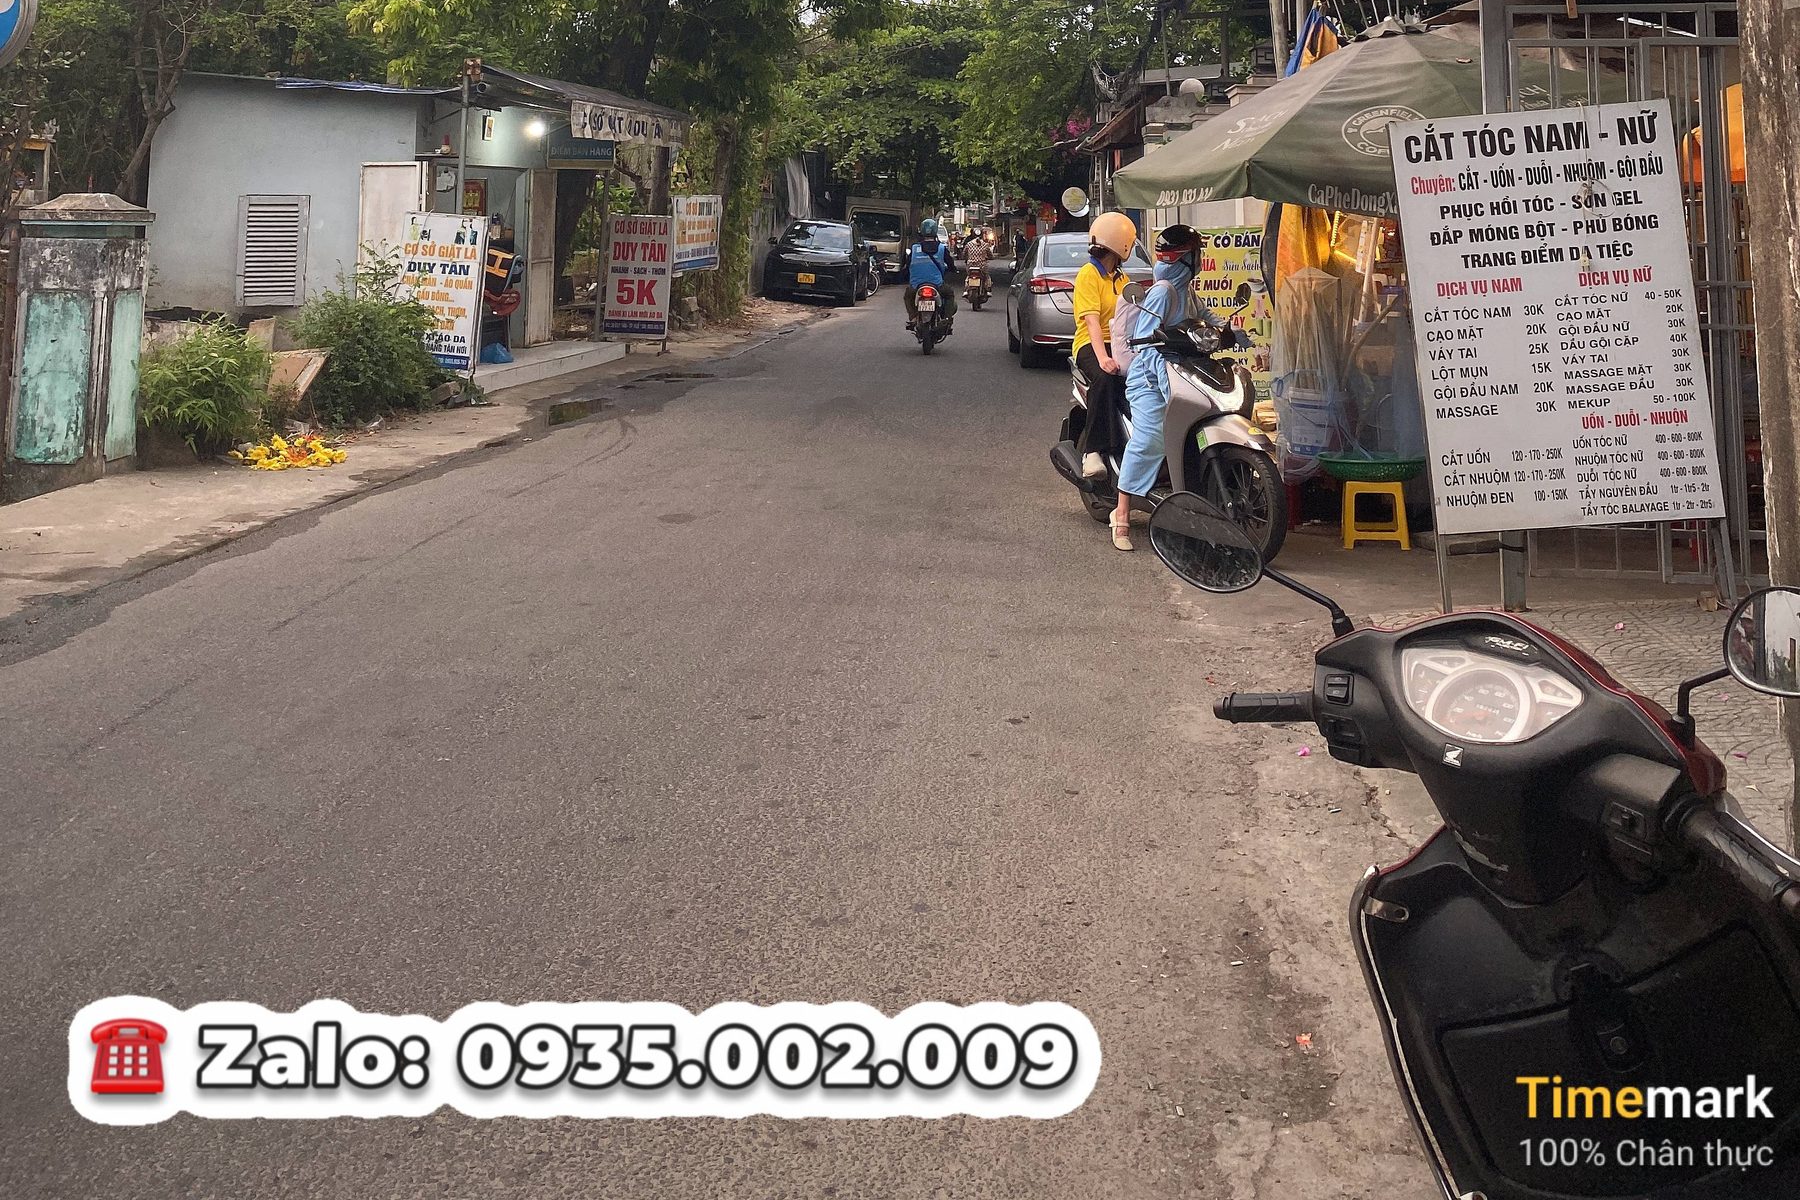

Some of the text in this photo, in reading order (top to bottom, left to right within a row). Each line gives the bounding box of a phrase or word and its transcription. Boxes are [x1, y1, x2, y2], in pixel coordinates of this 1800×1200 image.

[1404, 109, 1658, 164] CẮT TÓC NAM NỮ
[1411, 150, 1664, 195] Chuyên: CẮT UỐN DUỖI NHUỘM GỘI ĐẦU
[1440, 202, 1484, 221] PHỤC
[1490, 196, 1518, 216] HỒI
[1522, 195, 1554, 213] TÓC
[1612, 190, 1643, 206] GEL
[1430, 214, 1659, 246] ĐẮP MÓNG BỘT PHỦ BÓNG
[1214, 231, 1260, 248] CÓ BÁN
[613, 241, 639, 262] DUY
[641, 240, 667, 262] TÂN
[1461, 241, 1634, 269] TRANG ĐIỂM TIỆC
[1203, 274, 1232, 291] MUỐI
[1578, 266, 1653, 289] DỊCH VỤ NỮ
[616, 279, 658, 305] 5K
[1437, 277, 1523, 299] DỊCH VỤ NAM
[1554, 289, 1682, 306] CẮT TÓC NỮ 40 50K
[1424, 304, 1544, 323] CẮT TÓC NAM 30K
[1556, 304, 1684, 322] CẠO MẶT 20K
[1427, 323, 1547, 343] CẠO MẶT 20K
[1558, 324, 1580, 336] GỘI
[1613, 321, 1630, 332] NỮ
[1668, 318, 1686, 328] 30K
[1589, 337, 1611, 349] GỘI
[1615, 336, 1639, 348] CẶP
[1670, 333, 1688, 343] 40K
[1429, 342, 1550, 361] VÁY TAI 25K
[1562, 348, 1690, 365] VÁY TAI 30K
[1431, 362, 1552, 382] LỘT MỤN 15K
[1564, 362, 1692, 380] MASSAGE MẶT 30K
[1433, 385, 1456, 401] GỘI
[1491, 383, 1519, 396] NAM
[1534, 381, 1555, 393] 20K
[1566, 382, 1626, 394] MASSAGE
[1676, 377, 1694, 387] 30K
[1436, 400, 1557, 419] MASSAGE 30K
[1568, 392, 1696, 409] MEKUP 50 100K
[1582, 412, 1604, 430] UỐN
[1650, 408, 1688, 427] NHUỘN
[1572, 434, 1628, 449] UỐN TÓC NỮ
[1441, 448, 1491, 466] CẮT UỐN
[1575, 450, 1644, 466] NHUỘM TÓC NỮ
[1444, 469, 1510, 487] CẮT NHUỘM
[1603, 468, 1621, 480] TÓC
[1624, 467, 1638, 480] NỮ
[1446, 491, 1514, 508] NHUỘM ĐEN
[1579, 484, 1596, 500] TẨY
[1599, 485, 1637, 498] NGUYÊN
[1581, 500, 1670, 516] TẨY TÓC BALAYAGE
